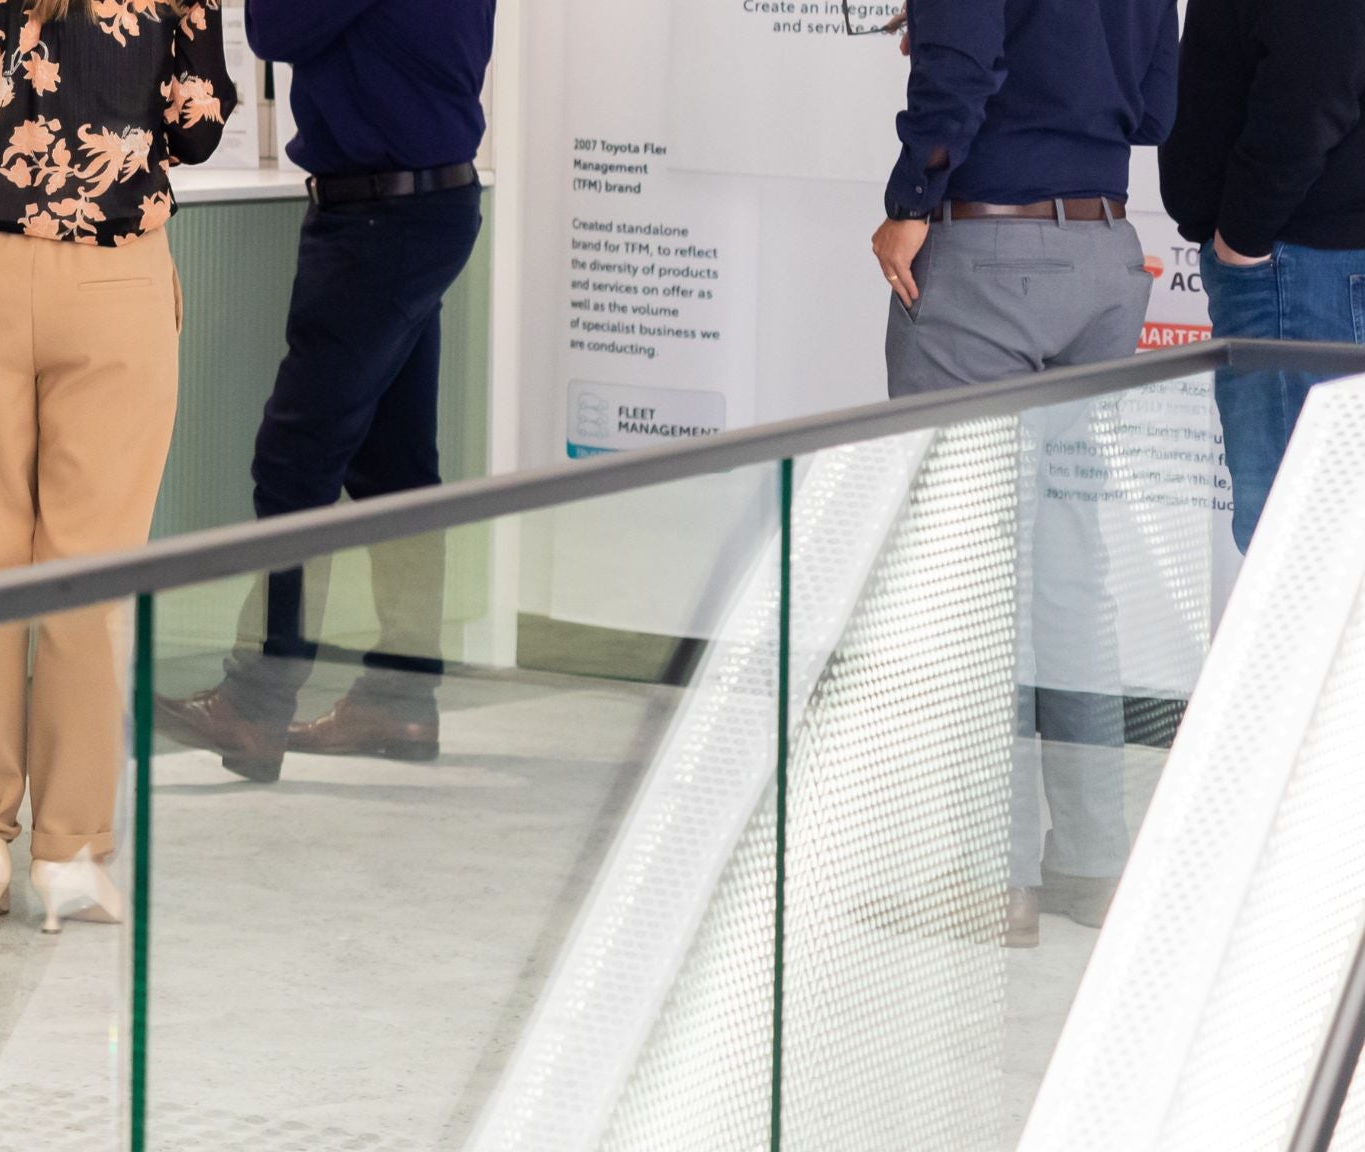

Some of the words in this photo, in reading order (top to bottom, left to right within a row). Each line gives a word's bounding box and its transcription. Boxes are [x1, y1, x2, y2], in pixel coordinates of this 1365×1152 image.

[743, 0, 795, 13] Create
[801, 3, 818, 13] an
[773, 20, 801, 33] and
[574, 138, 596, 150] 2007
[601, 141, 639, 156] Toyota
[574, 159, 648, 174] Management
[573, 178, 602, 193] (TFM)
[605, 182, 641, 194] brand
[572, 218, 612, 233] Created
[617, 223, 688, 237] standalone
[572, 238, 601, 251] brand
[604, 241, 620, 252] for
[624, 242, 653, 257] TFM,
[658, 245, 670, 256] to
[675, 246, 717, 259] reflect
[1171, 246, 1200, 267] TO
[572, 258, 586, 269] the
[590, 260, 638, 277] diversity
[642, 264, 655, 275] of
[659, 266, 718, 279] products
[572, 279, 589, 290] and
[592, 281, 638, 294] services
[642, 286, 658, 295] on
[663, 285, 692, 297] offer
[698, 289, 712, 299] as
[1170, 272, 1201, 292] AC
[571, 300, 590, 310] well
[594, 302, 605, 312] as
[609, 302, 628, 313] the
[632, 304, 679, 317] volume
[570, 317, 579, 328] of
[583, 320, 635, 334] specialist
[640, 325, 696, 338] business
[701, 330, 720, 339] we
[570, 340, 584, 349] are
[588, 342, 659, 359] conducting.
[619, 406, 656, 420] FLEET
